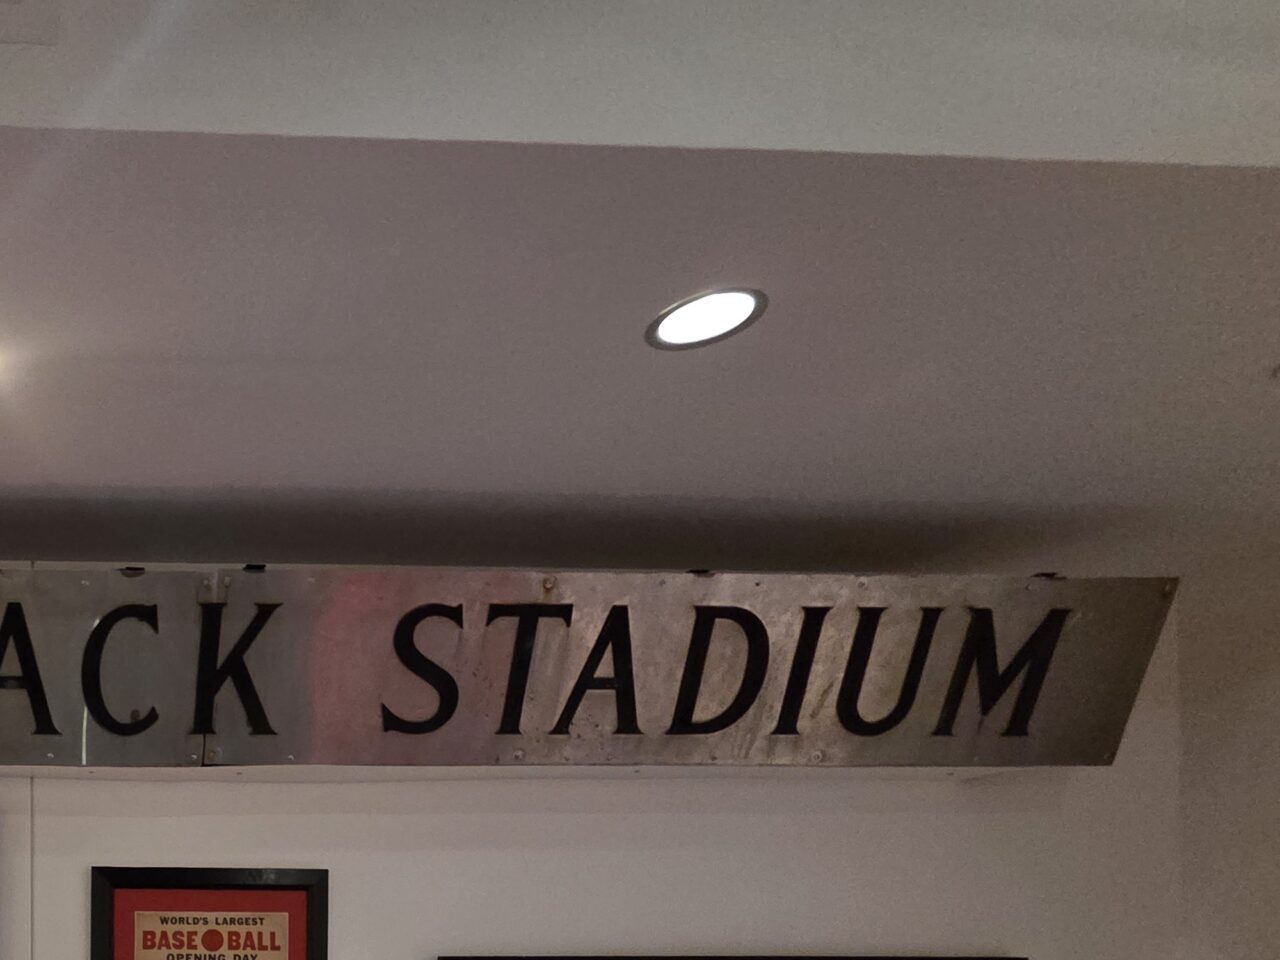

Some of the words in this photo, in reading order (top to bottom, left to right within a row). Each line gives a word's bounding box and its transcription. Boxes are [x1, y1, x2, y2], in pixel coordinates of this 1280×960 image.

[381, 602, 1073, 738] STADIUM
[159, 916, 209, 925] WORLD'S
[215, 917, 265, 926] LARGEST
[142, 930, 198, 950] BASE
[227, 931, 281, 951] BALL
